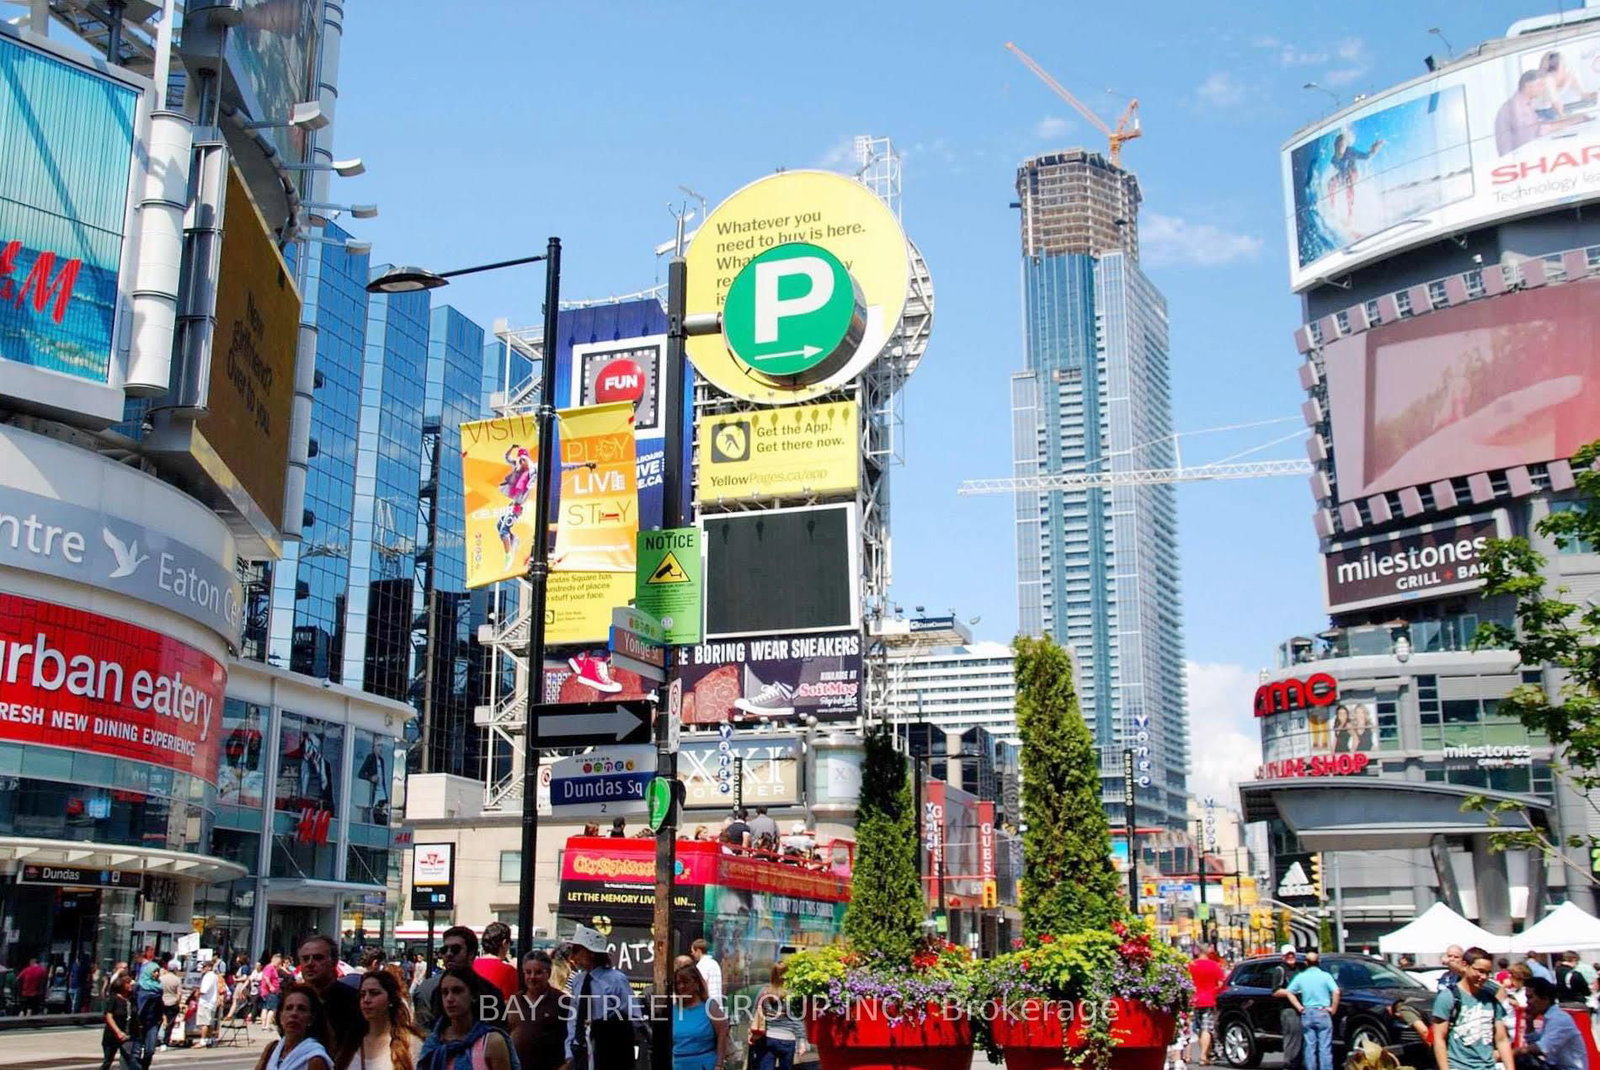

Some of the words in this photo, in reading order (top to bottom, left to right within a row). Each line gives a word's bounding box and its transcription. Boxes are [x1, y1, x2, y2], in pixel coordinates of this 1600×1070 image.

[1492, 175, 1578, 203] Technology
[716, 216, 791, 236] Whatever
[794, 211, 821, 228] you
[716, 235, 755, 254] need
[760, 234, 774, 248] to
[810, 226, 823, 240] is
[827, 222, 867, 238] here.
[755, 256, 835, 345] P
[604, 374, 638, 391] FUN
[756, 427, 778, 438] Get
[782, 425, 801, 436] the
[805, 422, 832, 435] App.
[756, 442, 778, 454] Get
[782, 439, 814, 451] there
[817, 438, 846, 449] now.
[645, 534, 694, 551] NOTICE
[1337, 536, 1488, 584] milestones
[158, 552, 220, 615] Eaton
[1396, 571, 1441, 590] GRILL
[623, 631, 651, 660] Yonge
[694, 642, 746, 665] BORING
[750, 640, 789, 661] WEAR
[791, 635, 860, 659] SNEAKERS
[131, 669, 213, 741] eatery
[1254, 672, 1338, 717] amc
[52, 710, 89, 732] NEW
[94, 718, 138, 742] DINING
[143, 728, 196, 757] EXPERIENCE
[1443, 743, 1531, 758] milestones
[1310, 753, 1369, 776] SHOP
[564, 778, 623, 798] Dundas
[627, 779, 643, 798] Sq
[600, 803, 607, 813] 2
[42, 867, 80, 881] Dundas
[568, 892, 581, 902] LET
[583, 892, 599, 903] THE
[601, 893, 639, 904] MEMORY
